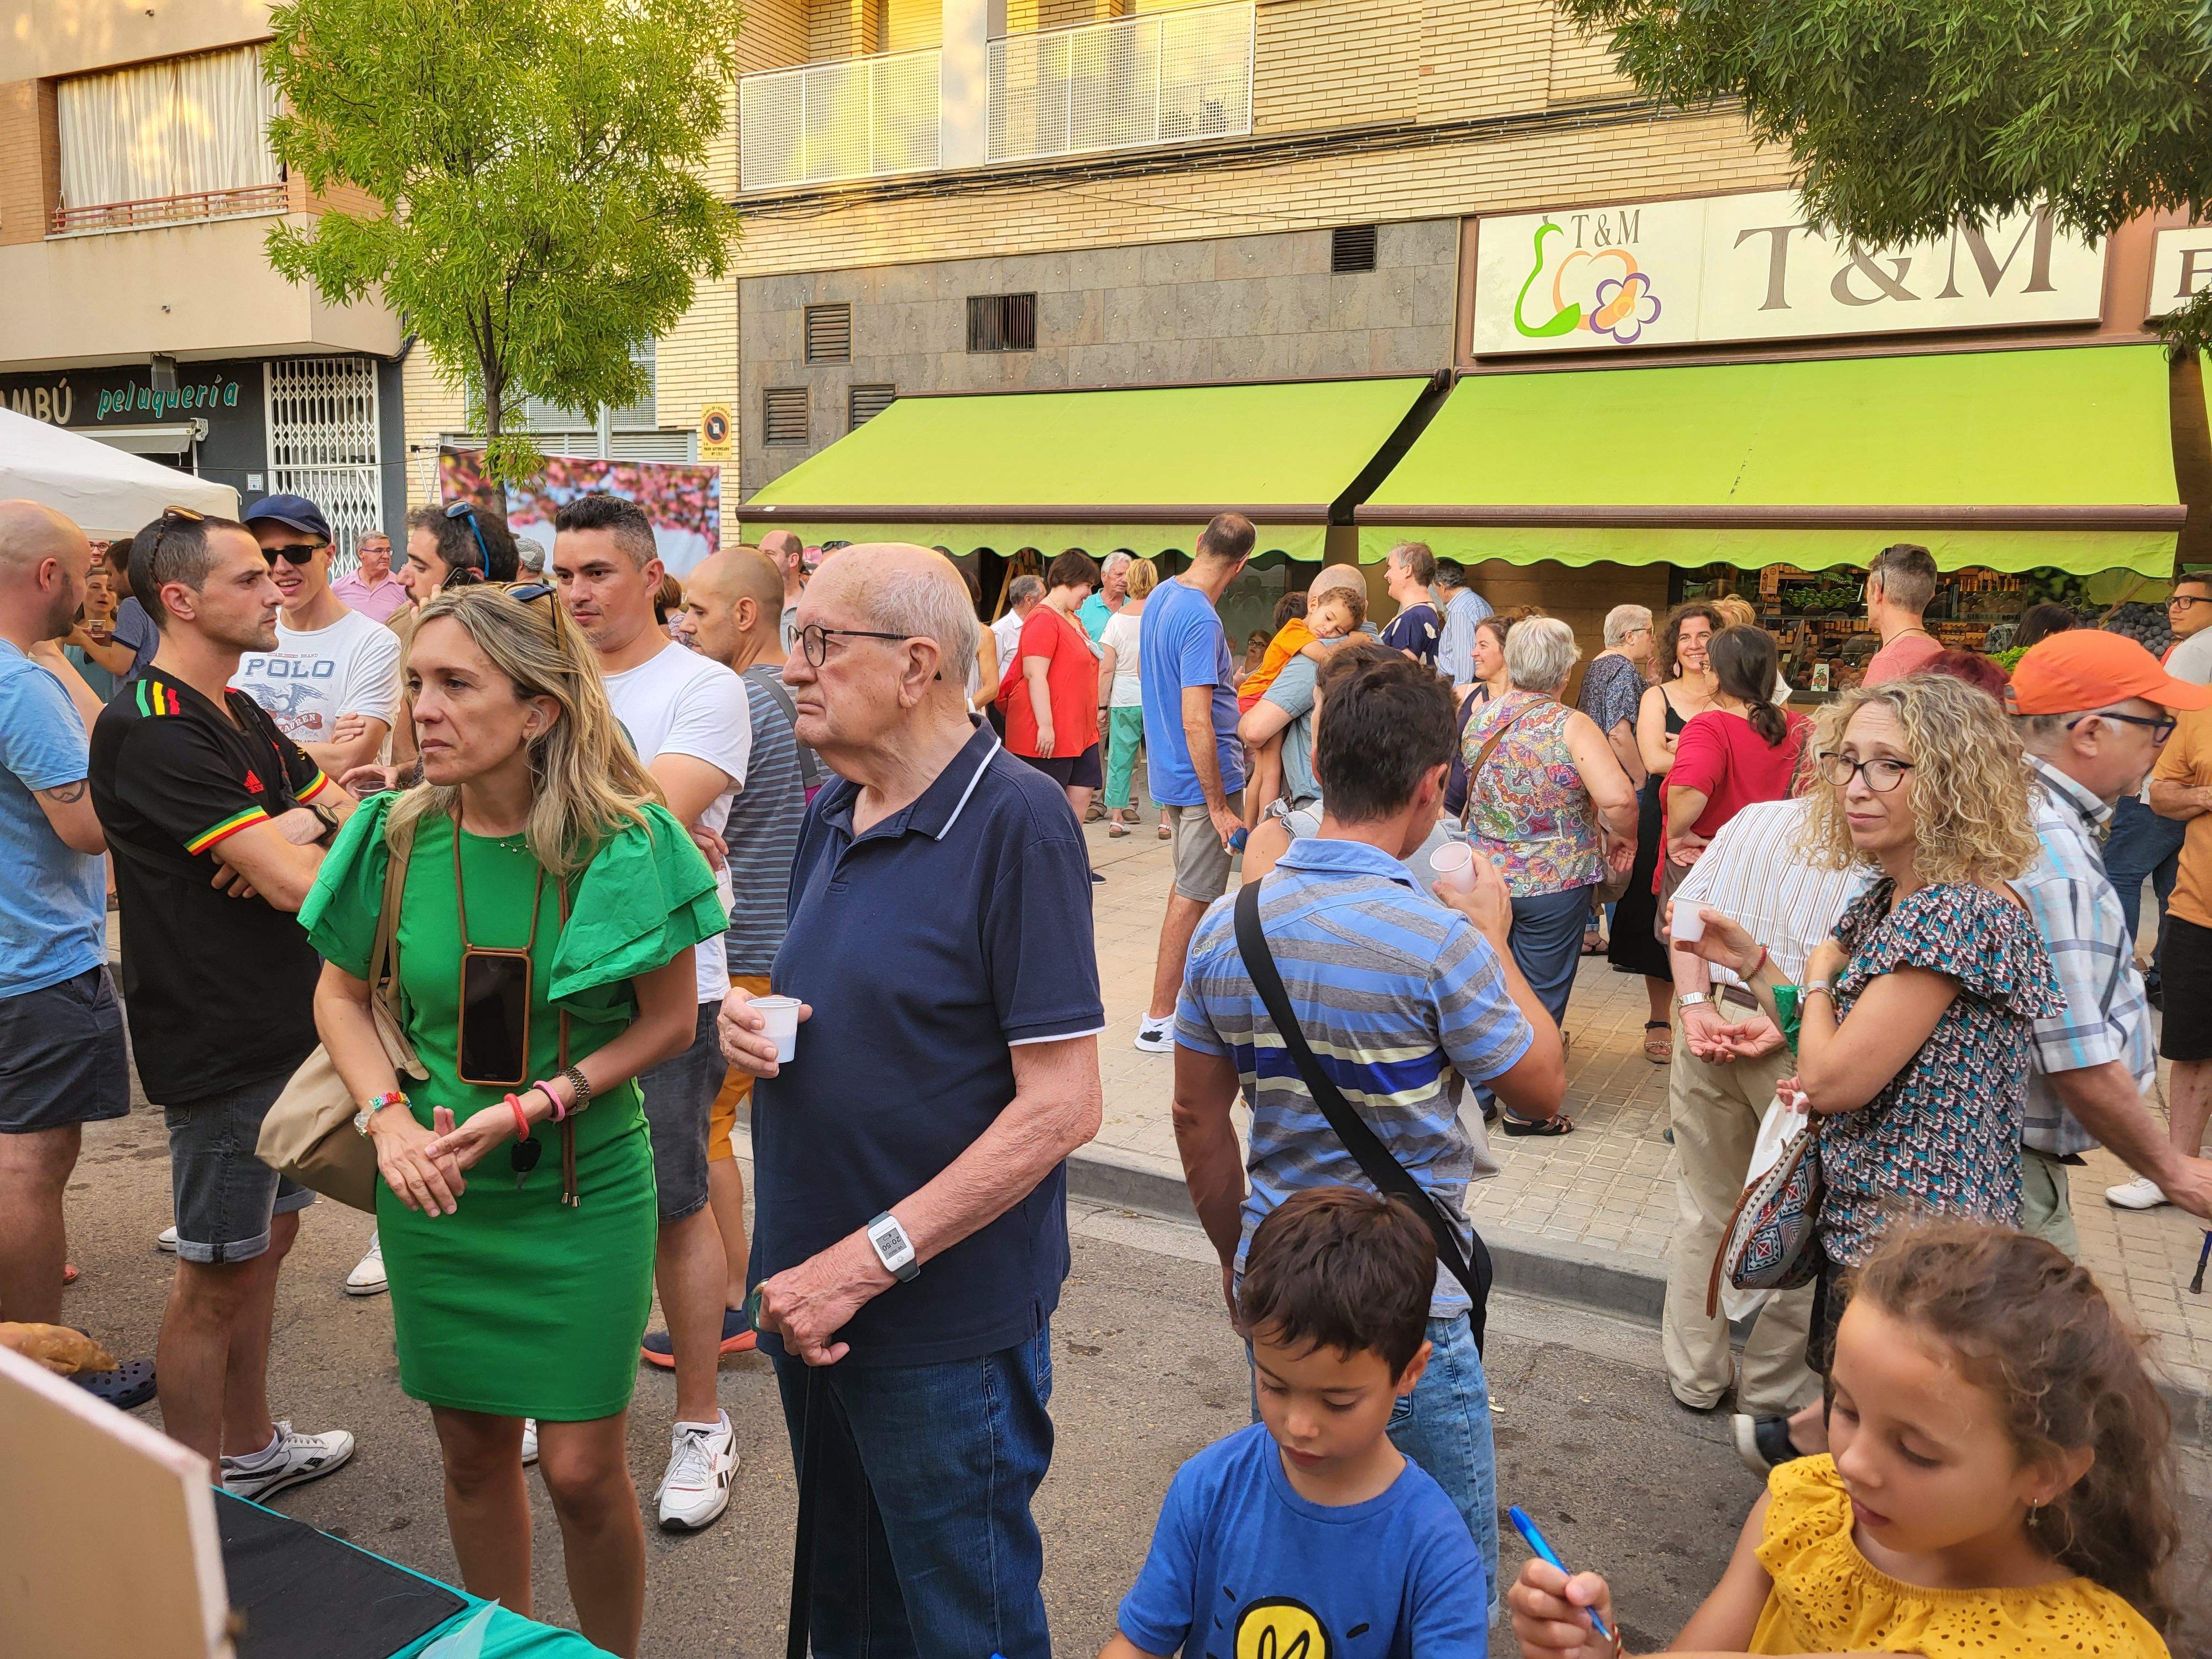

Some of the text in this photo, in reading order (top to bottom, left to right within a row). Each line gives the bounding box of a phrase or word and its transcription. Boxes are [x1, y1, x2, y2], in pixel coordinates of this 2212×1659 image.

[97, 374, 238, 420] peluquería
[244, 658, 336, 679] POLO
[882, 1236, 901, 1251] 20:50
